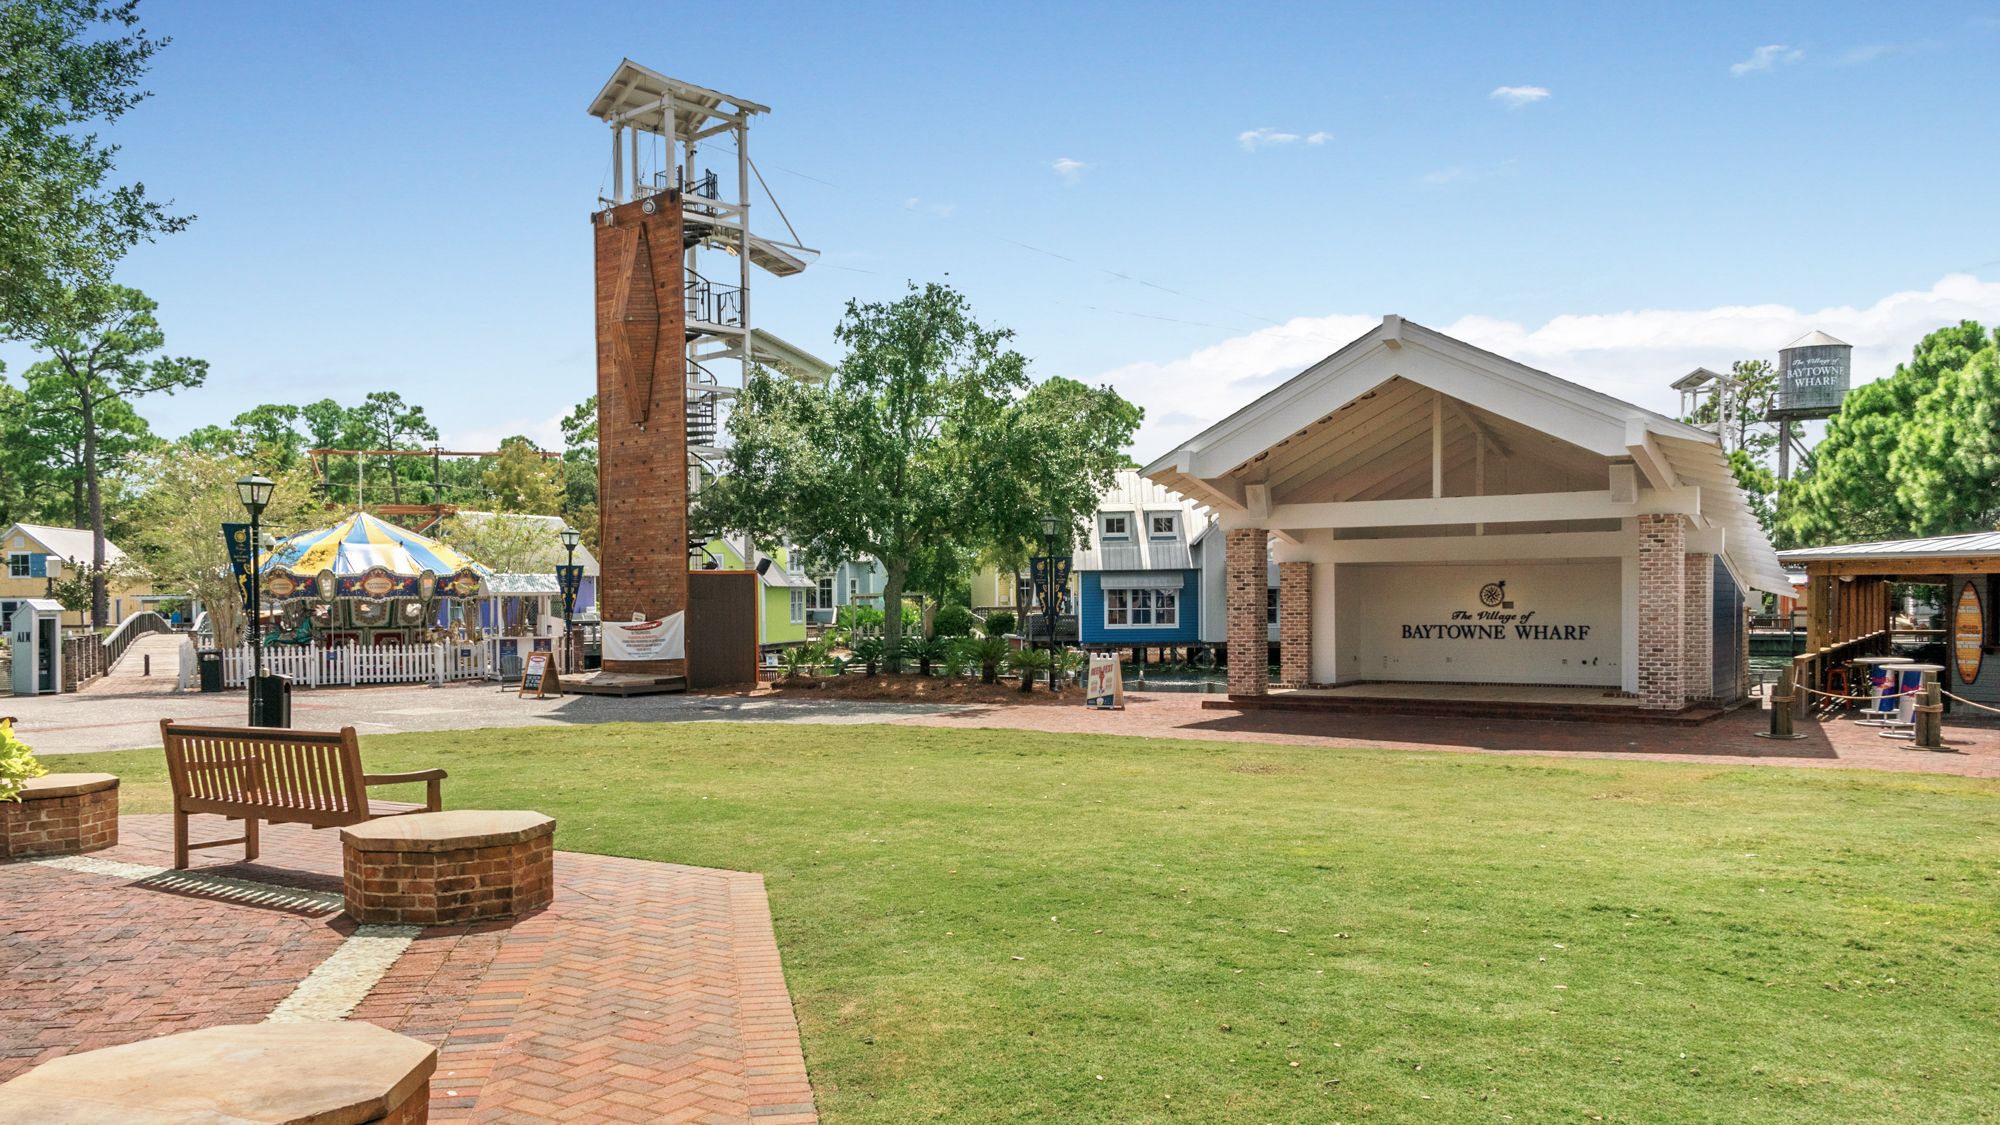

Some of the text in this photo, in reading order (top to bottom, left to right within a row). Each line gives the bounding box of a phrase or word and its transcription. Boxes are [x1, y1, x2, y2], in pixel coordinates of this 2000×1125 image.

[1787, 366, 1844, 379] BAYTOWNE
[1795, 376, 1837, 386] WHARF
[1451, 610, 1536, 624] The Village of
[1401, 624, 1591, 641] BAYTOWNE WHARF
